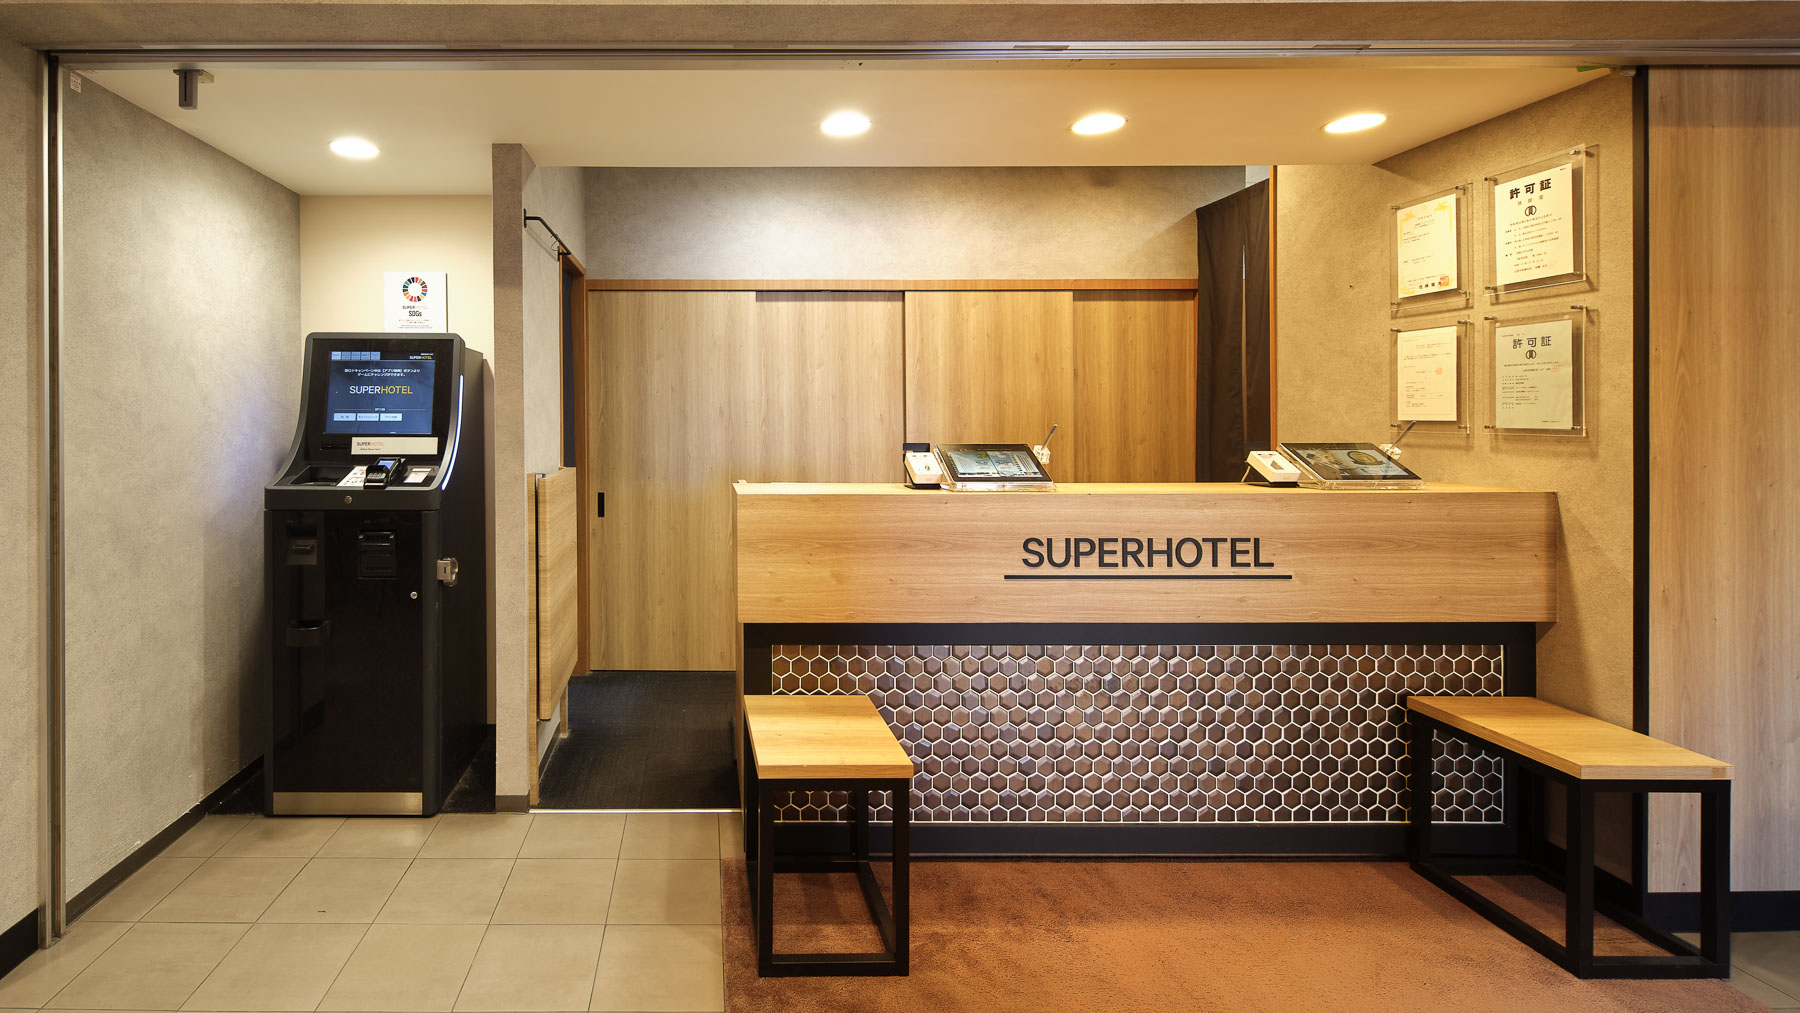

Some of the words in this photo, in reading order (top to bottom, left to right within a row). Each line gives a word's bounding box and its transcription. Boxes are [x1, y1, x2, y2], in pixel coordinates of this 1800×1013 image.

[1509, 178, 1552, 200] 許可証
[1512, 335, 1552, 349] 許可証
[349, 385, 413, 394] SUPERHOTEL
[1022, 537, 1274, 568] SUPERHOTEL
